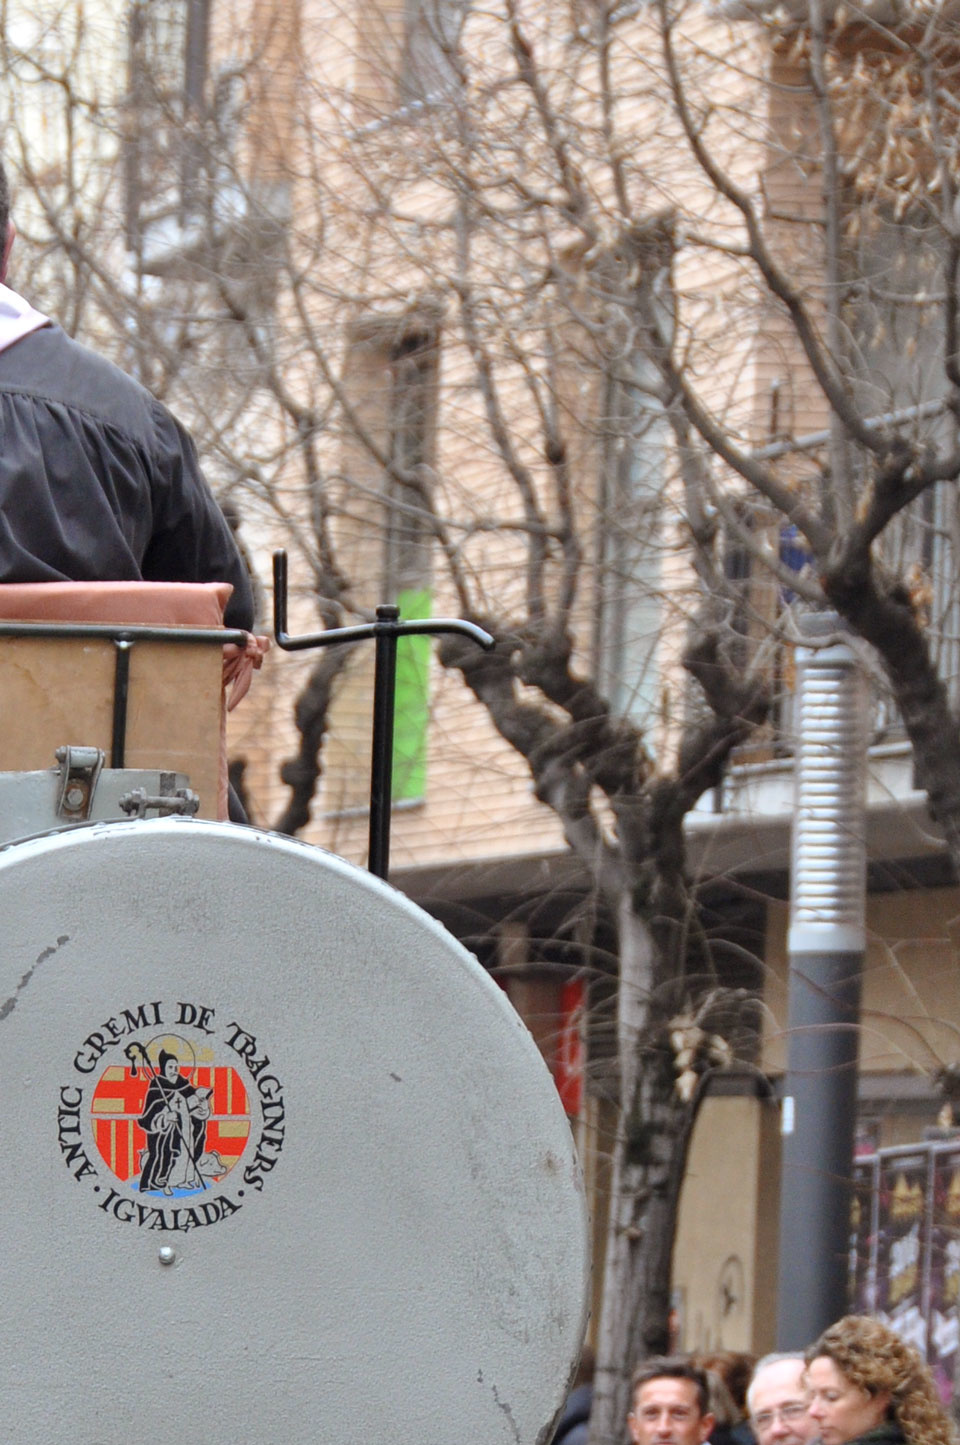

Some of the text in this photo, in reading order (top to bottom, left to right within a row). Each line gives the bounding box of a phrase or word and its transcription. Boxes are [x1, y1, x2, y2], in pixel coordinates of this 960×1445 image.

[57, 1001, 286, 1192] ANTIC GREMI DE TRAGINERS
